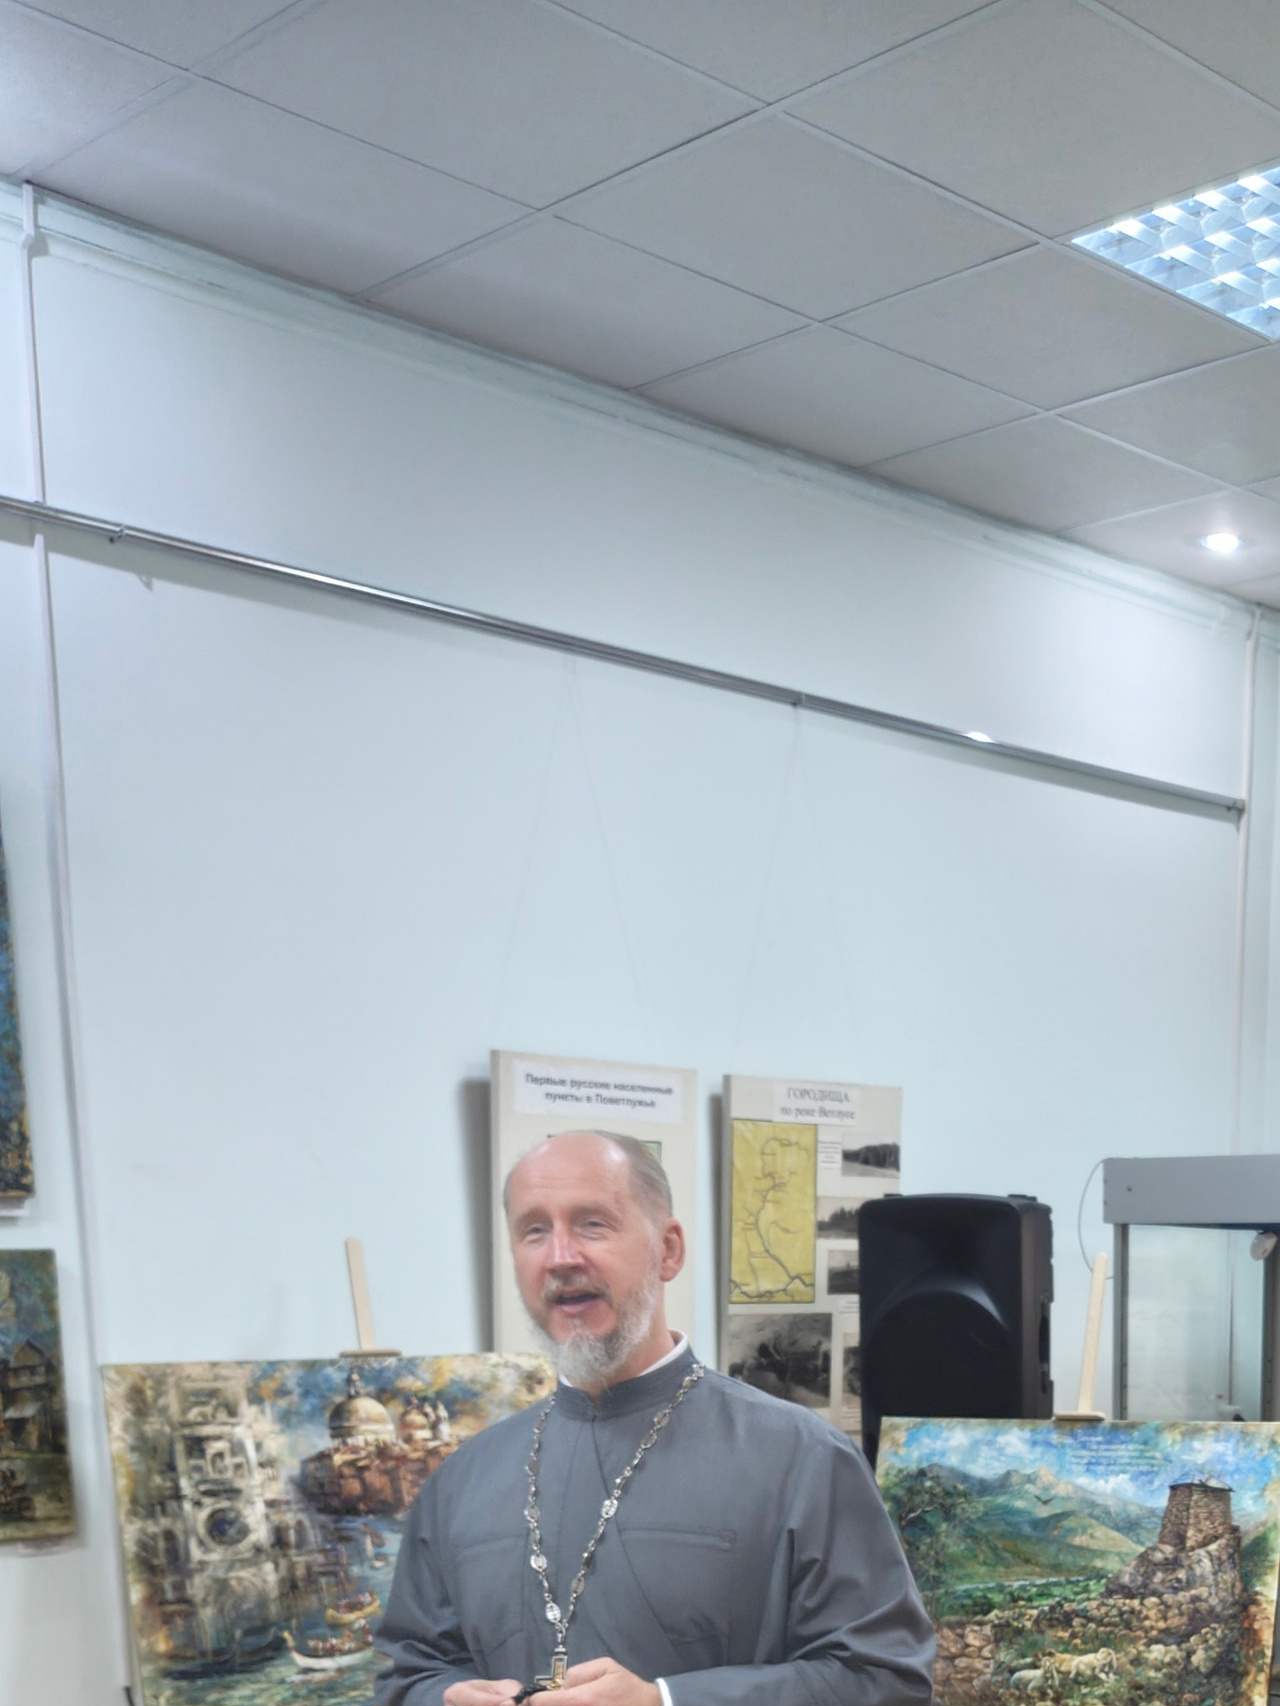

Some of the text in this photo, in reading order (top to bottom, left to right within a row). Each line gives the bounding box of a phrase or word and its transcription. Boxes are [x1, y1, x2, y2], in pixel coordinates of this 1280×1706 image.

[525, 1072, 567, 1087] Первые
[570, 1079, 610, 1091] русские
[545, 1091, 583, 1104] пункты
[787, 1087, 850, 1102] ГОРОДИЩА
